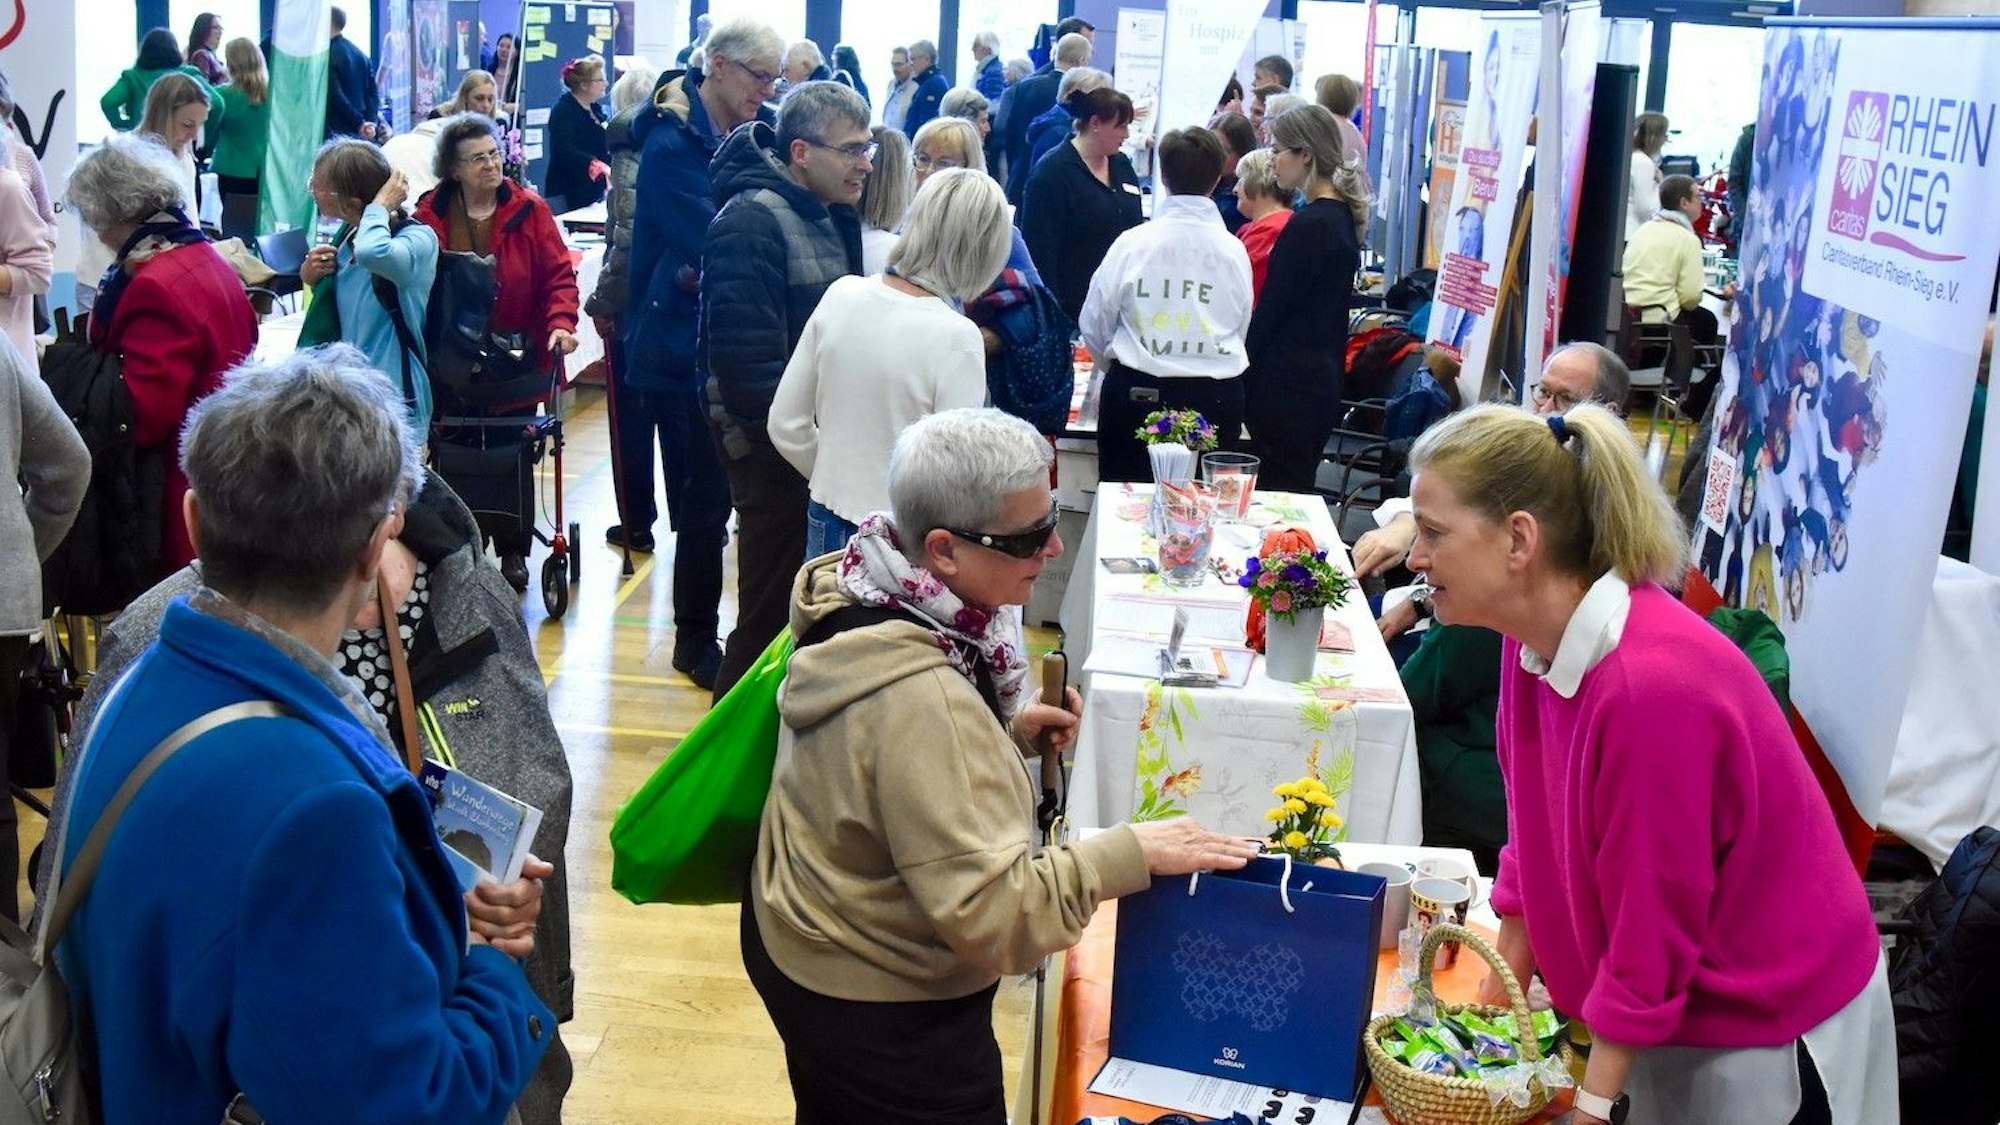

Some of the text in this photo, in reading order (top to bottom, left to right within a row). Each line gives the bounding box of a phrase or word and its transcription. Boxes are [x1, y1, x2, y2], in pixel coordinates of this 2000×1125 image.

[1190, 23, 1246, 43] Hospiz
[1886, 94, 1996, 167] RHEIN
[1876, 162, 1950, 235] SIEG
[1831, 208, 1865, 238] caritas
[1137, 278, 1213, 304] LIFE
[1885, 261, 1935, 301] Rhein-Sieg
[451, 782, 514, 832] Wanderwege
[1213, 1058, 1246, 1070] KORIAN
